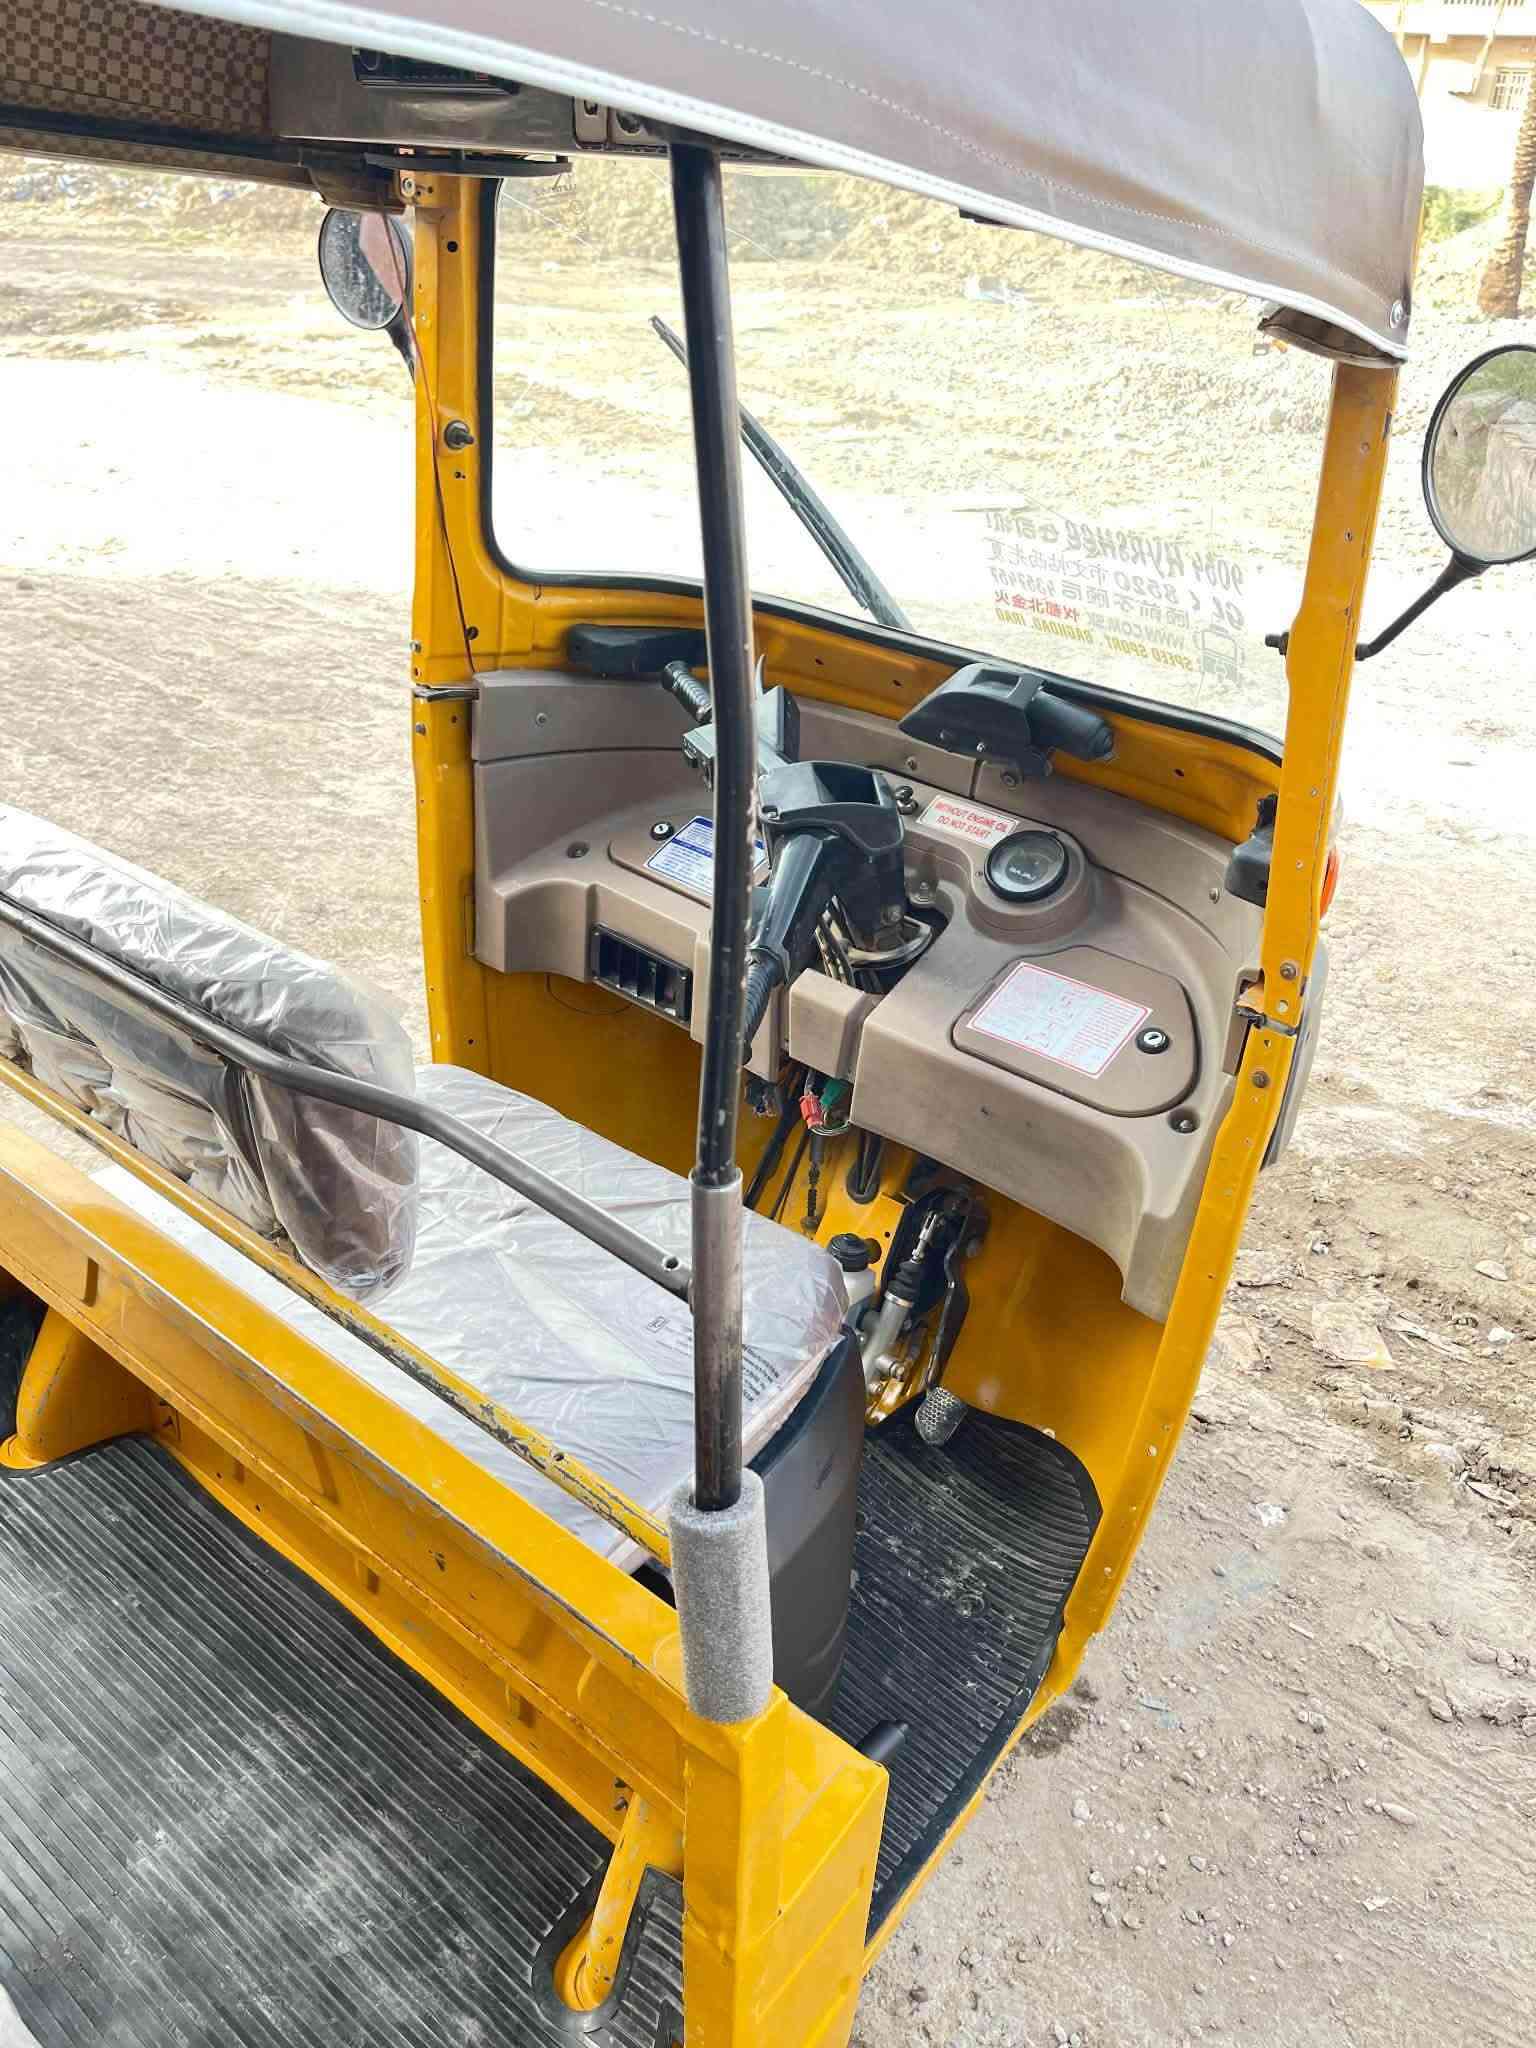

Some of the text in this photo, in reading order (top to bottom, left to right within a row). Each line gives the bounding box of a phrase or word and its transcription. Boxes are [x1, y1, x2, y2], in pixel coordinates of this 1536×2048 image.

[935, 802, 968, 818] WITHOUT
[967, 812, 996, 826] ENGINE
[936, 815, 992, 840] DO NOT START
